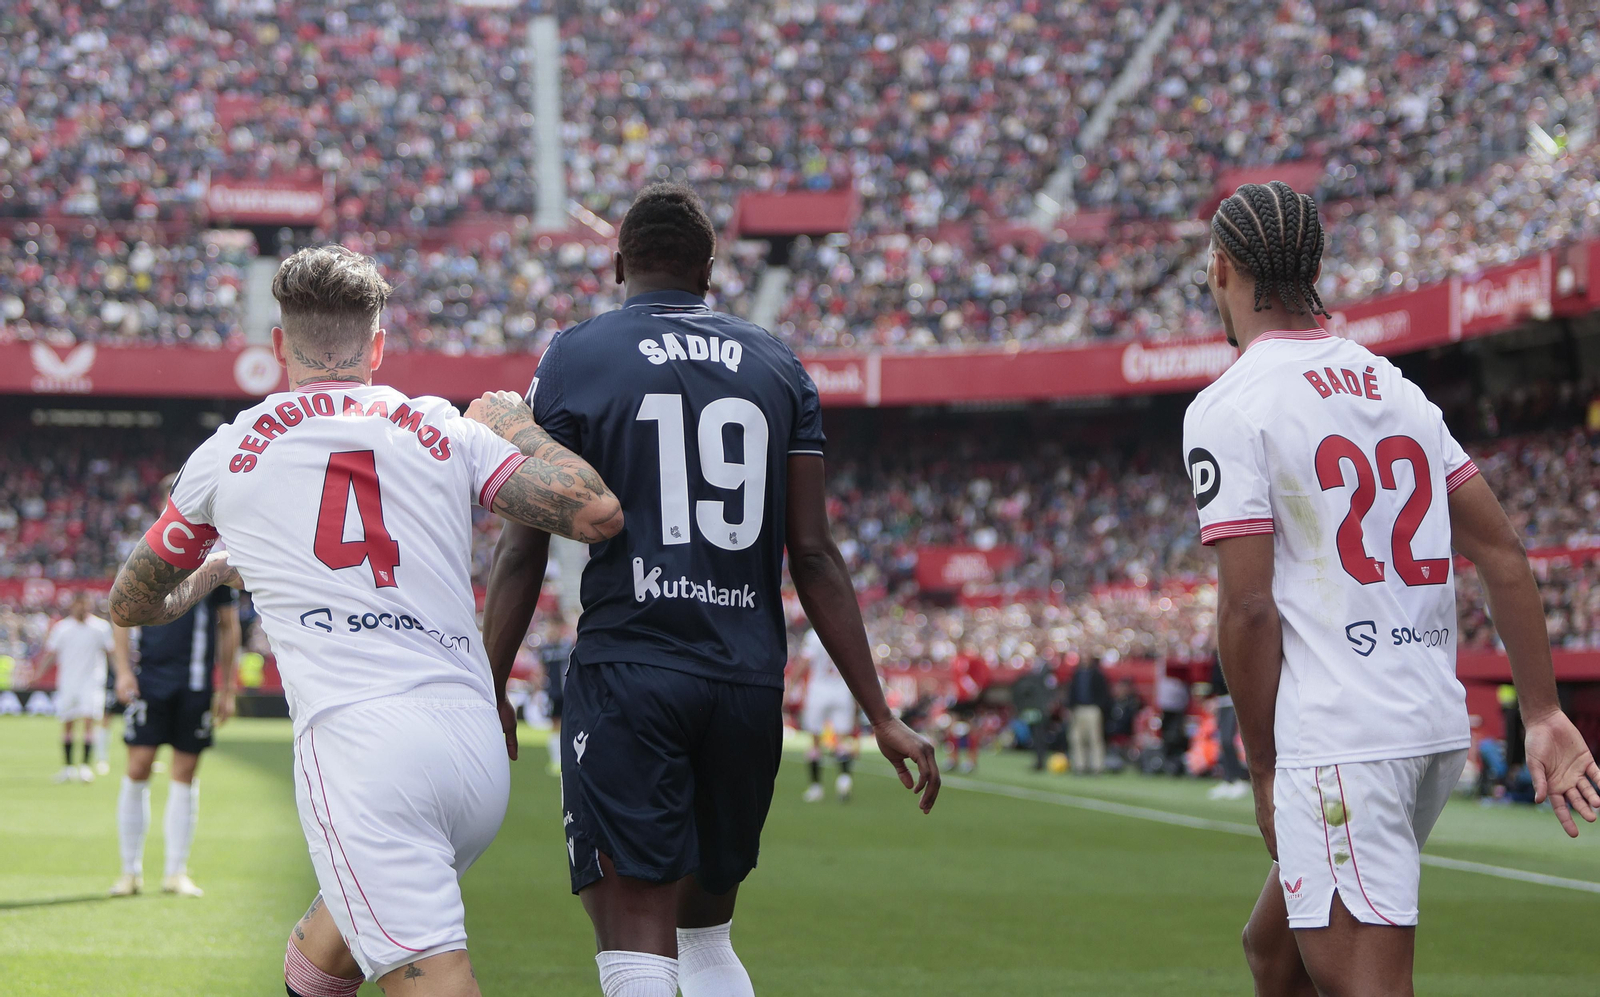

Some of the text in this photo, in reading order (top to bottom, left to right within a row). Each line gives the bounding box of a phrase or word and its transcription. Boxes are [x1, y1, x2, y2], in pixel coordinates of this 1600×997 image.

[638, 332, 743, 373] SADIQ
[1302, 365, 1382, 401] BADÉ
[228, 393, 453, 474] SERGIO RAMOS
[635, 393, 769, 551] 19
[162, 520, 196, 554] C
[313, 449, 400, 589] 4
[1314, 434, 1450, 587] 22
[632, 556, 756, 608] Kutxabank
